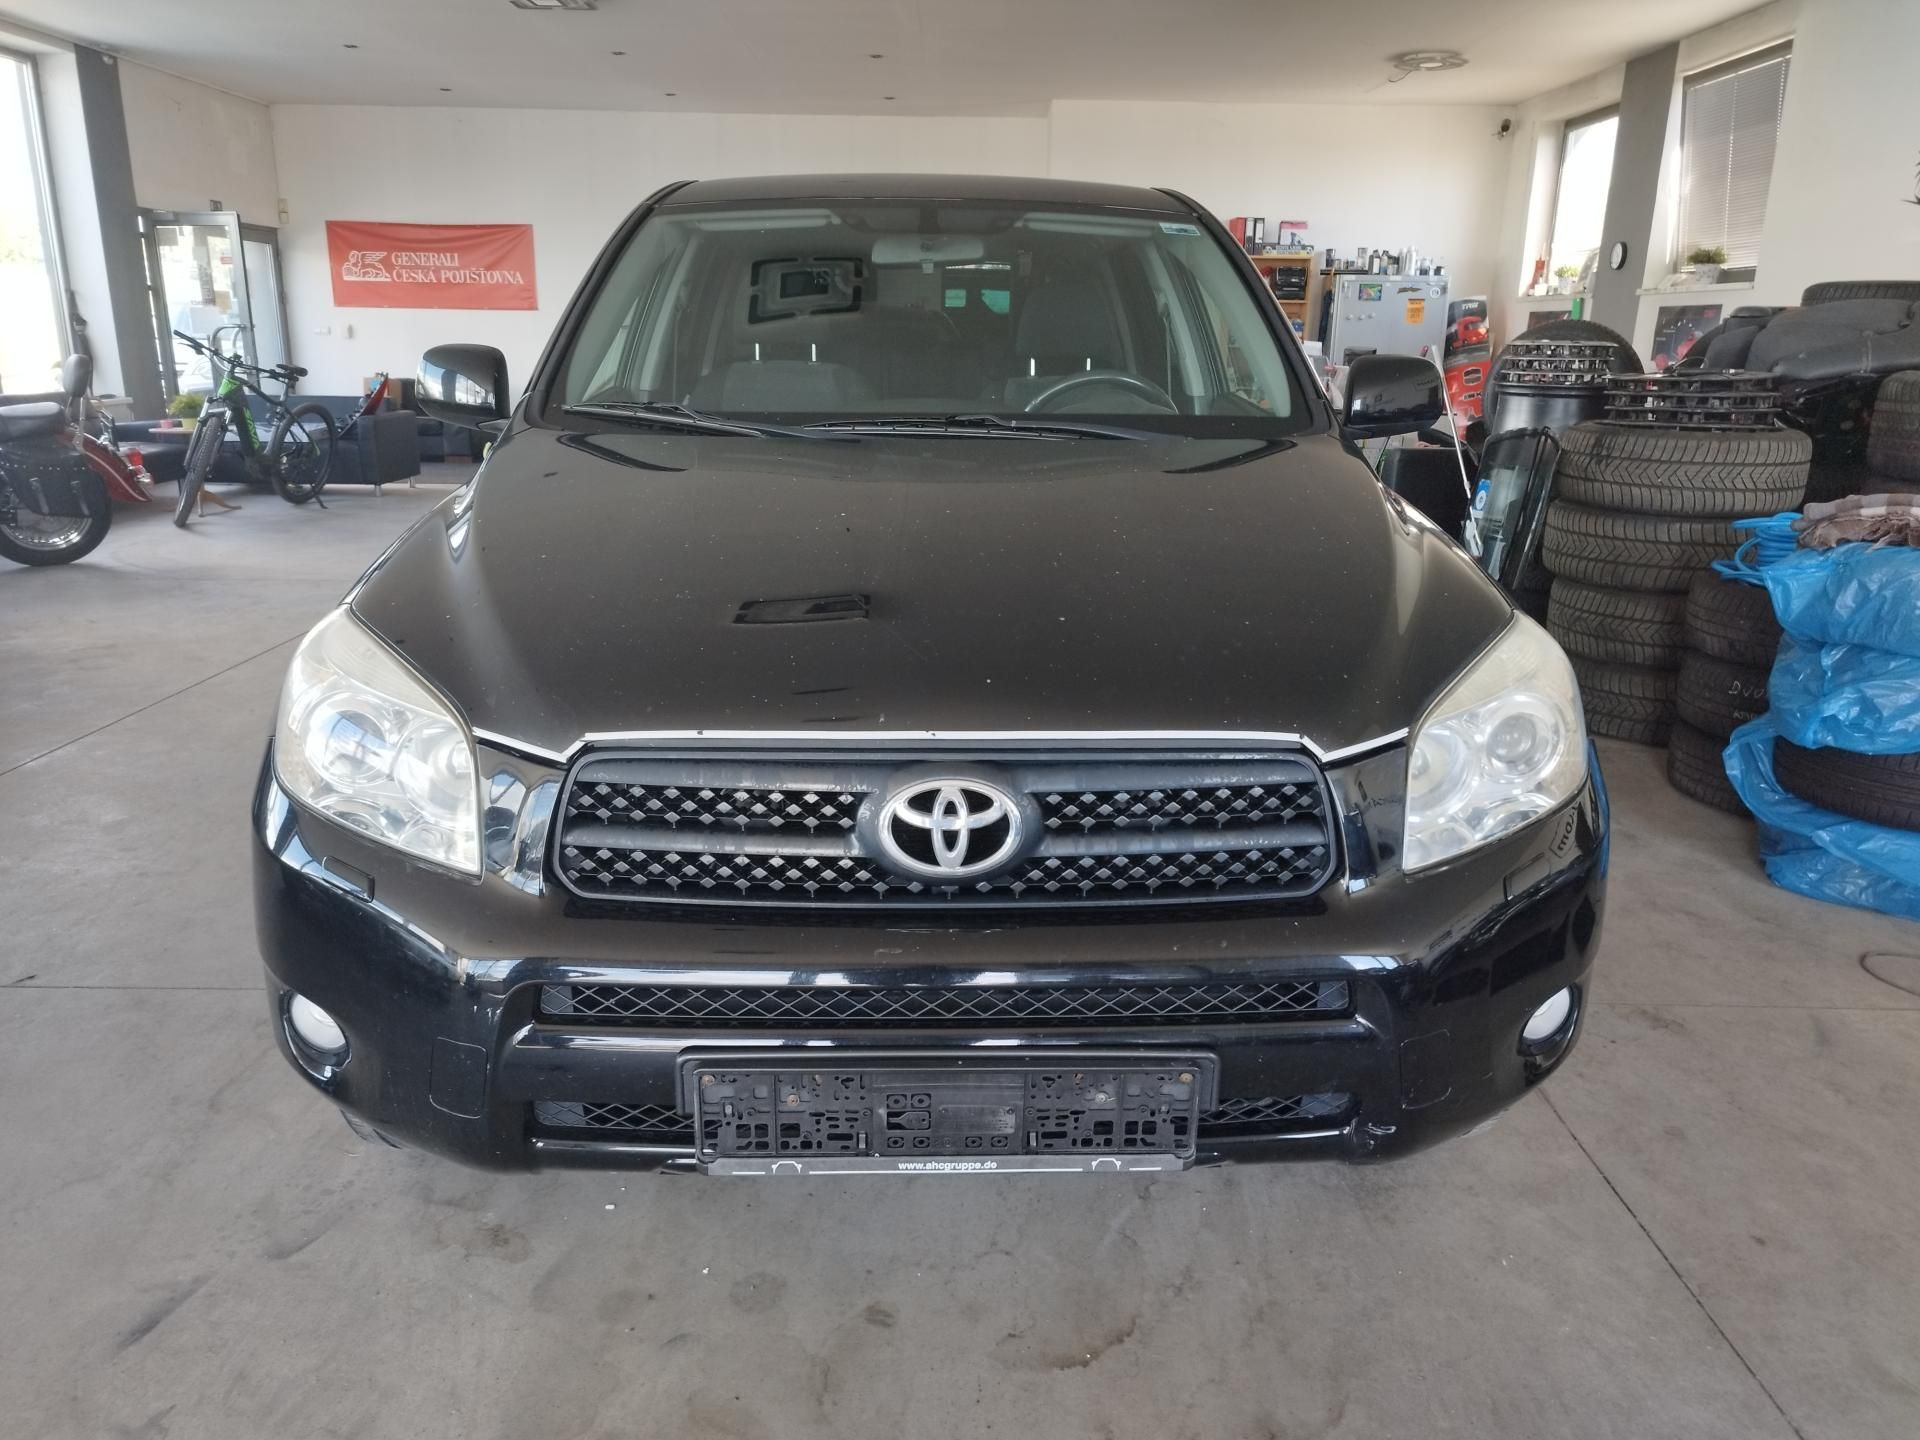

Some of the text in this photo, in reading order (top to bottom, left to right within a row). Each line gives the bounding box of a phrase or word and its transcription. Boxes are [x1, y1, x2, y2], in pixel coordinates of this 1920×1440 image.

[391, 252, 458, 267] GENERALI
[392, 265, 523, 284] ČESKÁ POJIŠŤOVNA
[898, 1160, 998, 1171] www.ahcgruppe.de
